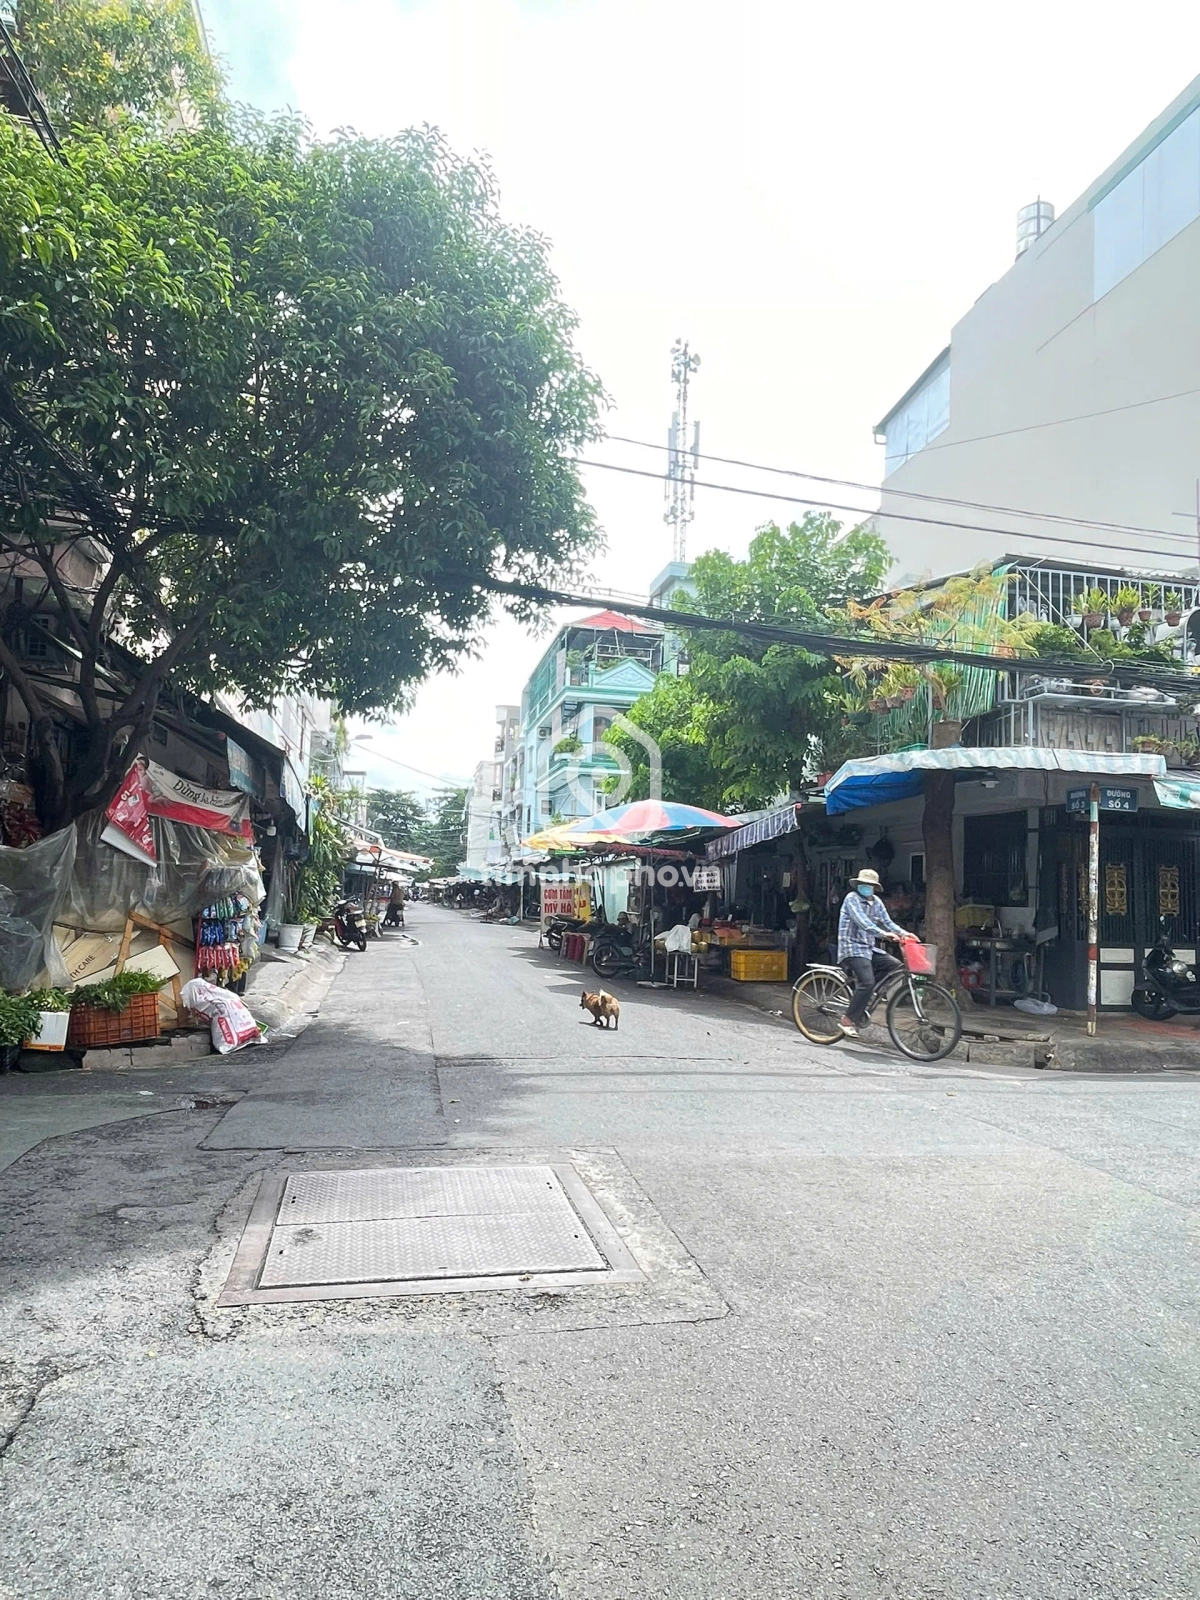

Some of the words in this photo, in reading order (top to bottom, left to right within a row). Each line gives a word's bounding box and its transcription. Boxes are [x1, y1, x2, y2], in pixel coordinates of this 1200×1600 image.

[1108, 798, 1121, 808] SỐ
[1123, 801, 1129, 809] 4
[78, 955, 95, 970] CARE
